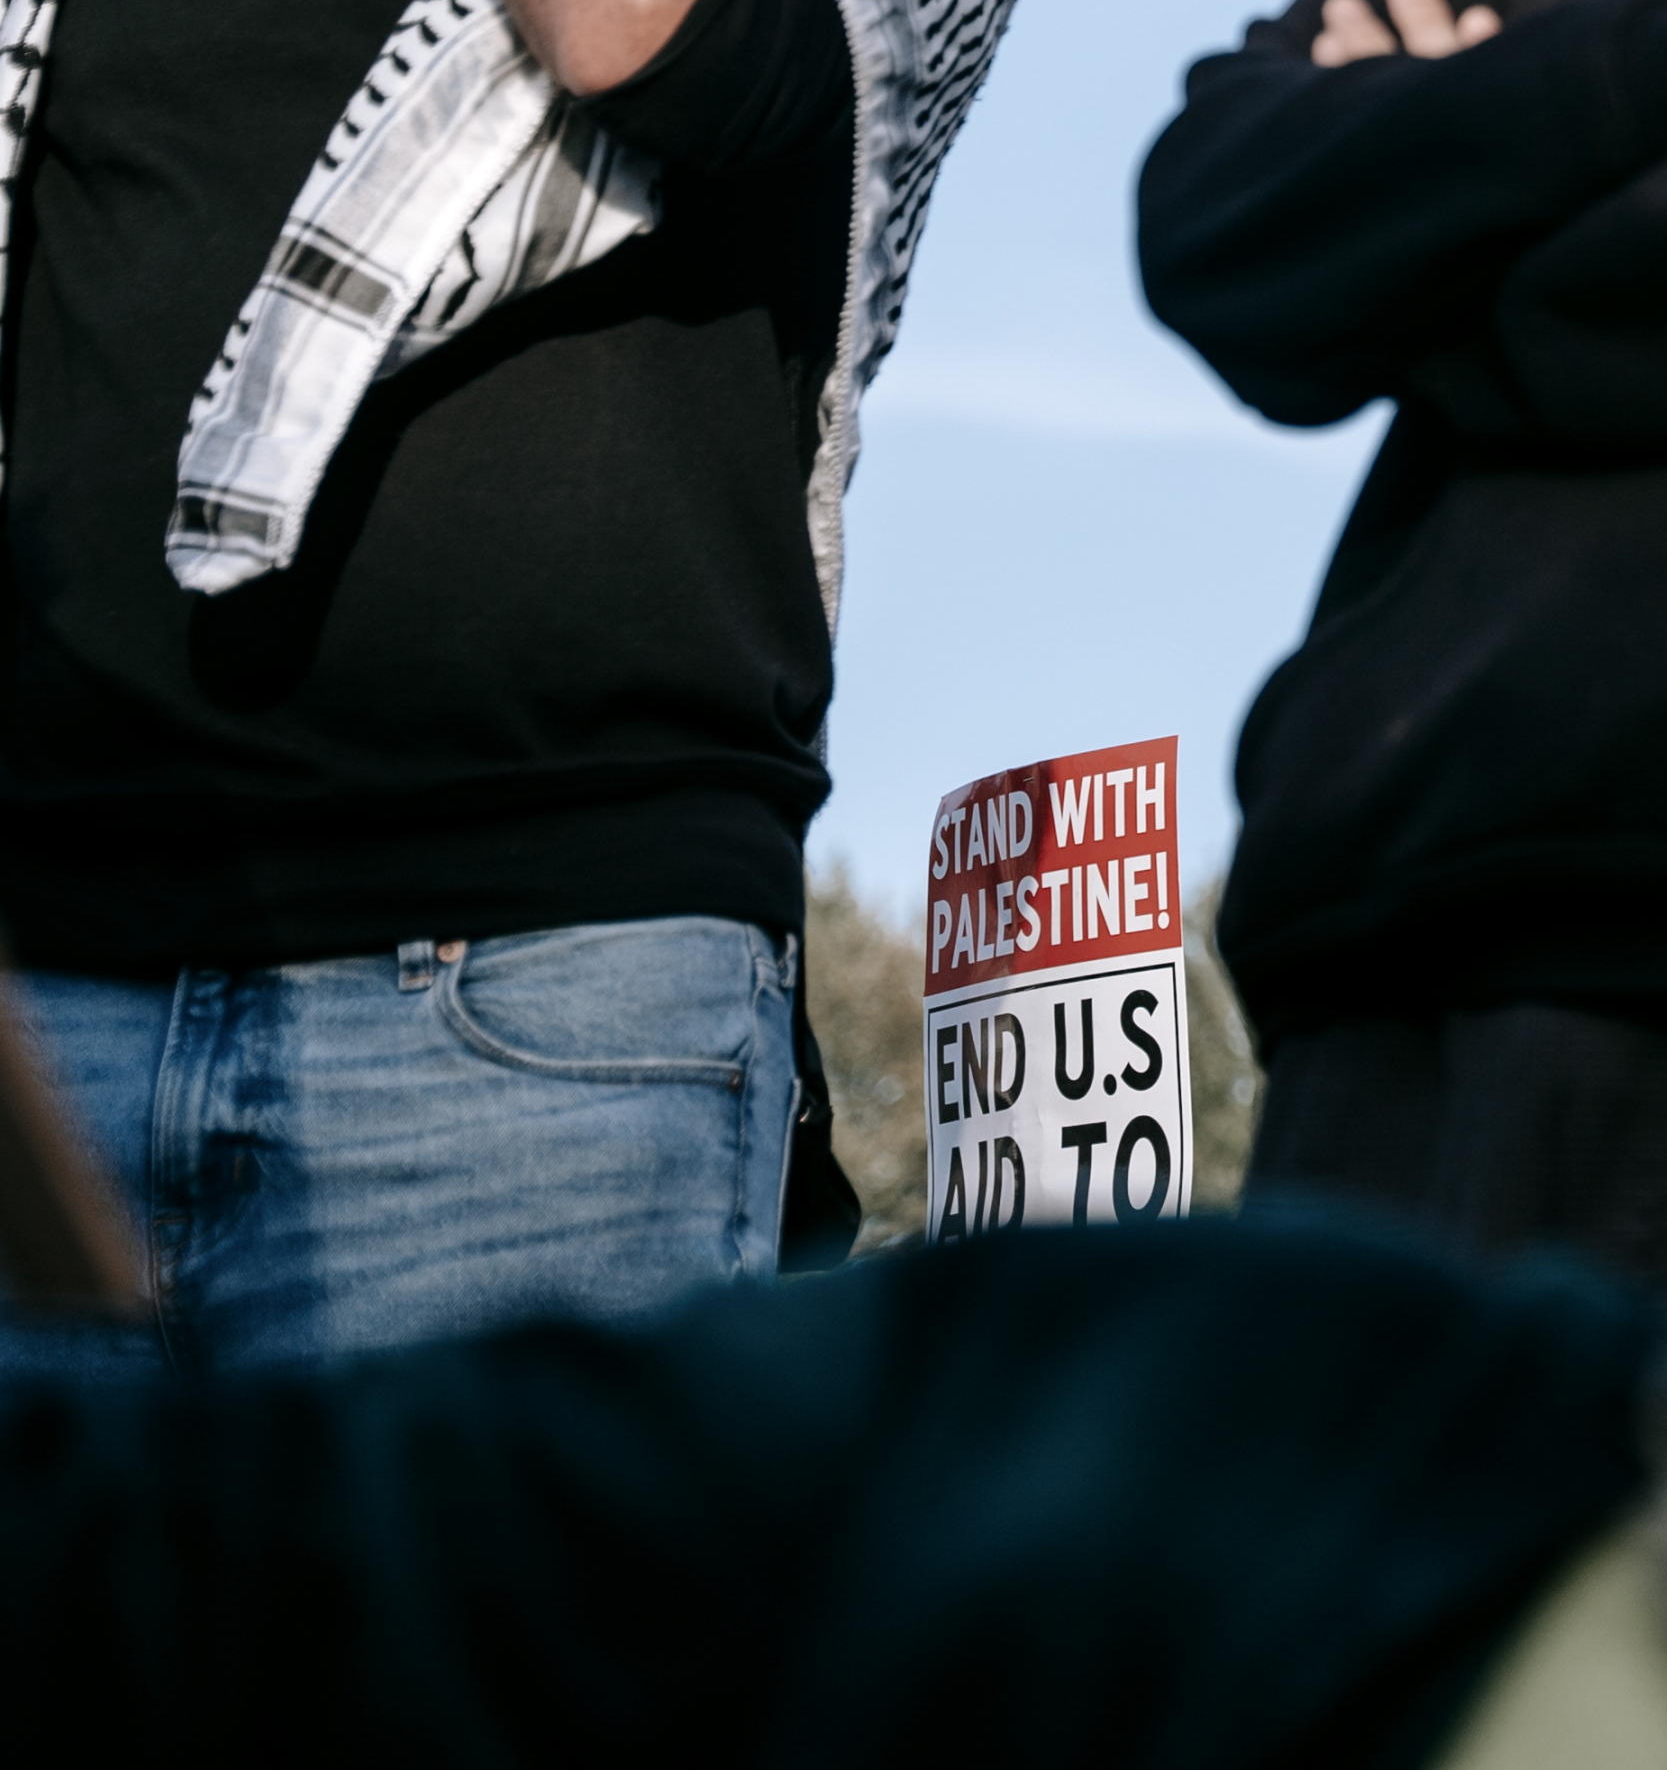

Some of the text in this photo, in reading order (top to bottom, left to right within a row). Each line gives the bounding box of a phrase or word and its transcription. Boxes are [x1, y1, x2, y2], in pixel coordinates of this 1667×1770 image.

[931, 761, 1167, 881] STAND WITH
[930, 851, 1171, 975] PALESTINE!
[936, 988, 1164, 1125] END U.S
[939, 1114, 1172, 1243] AID TO
